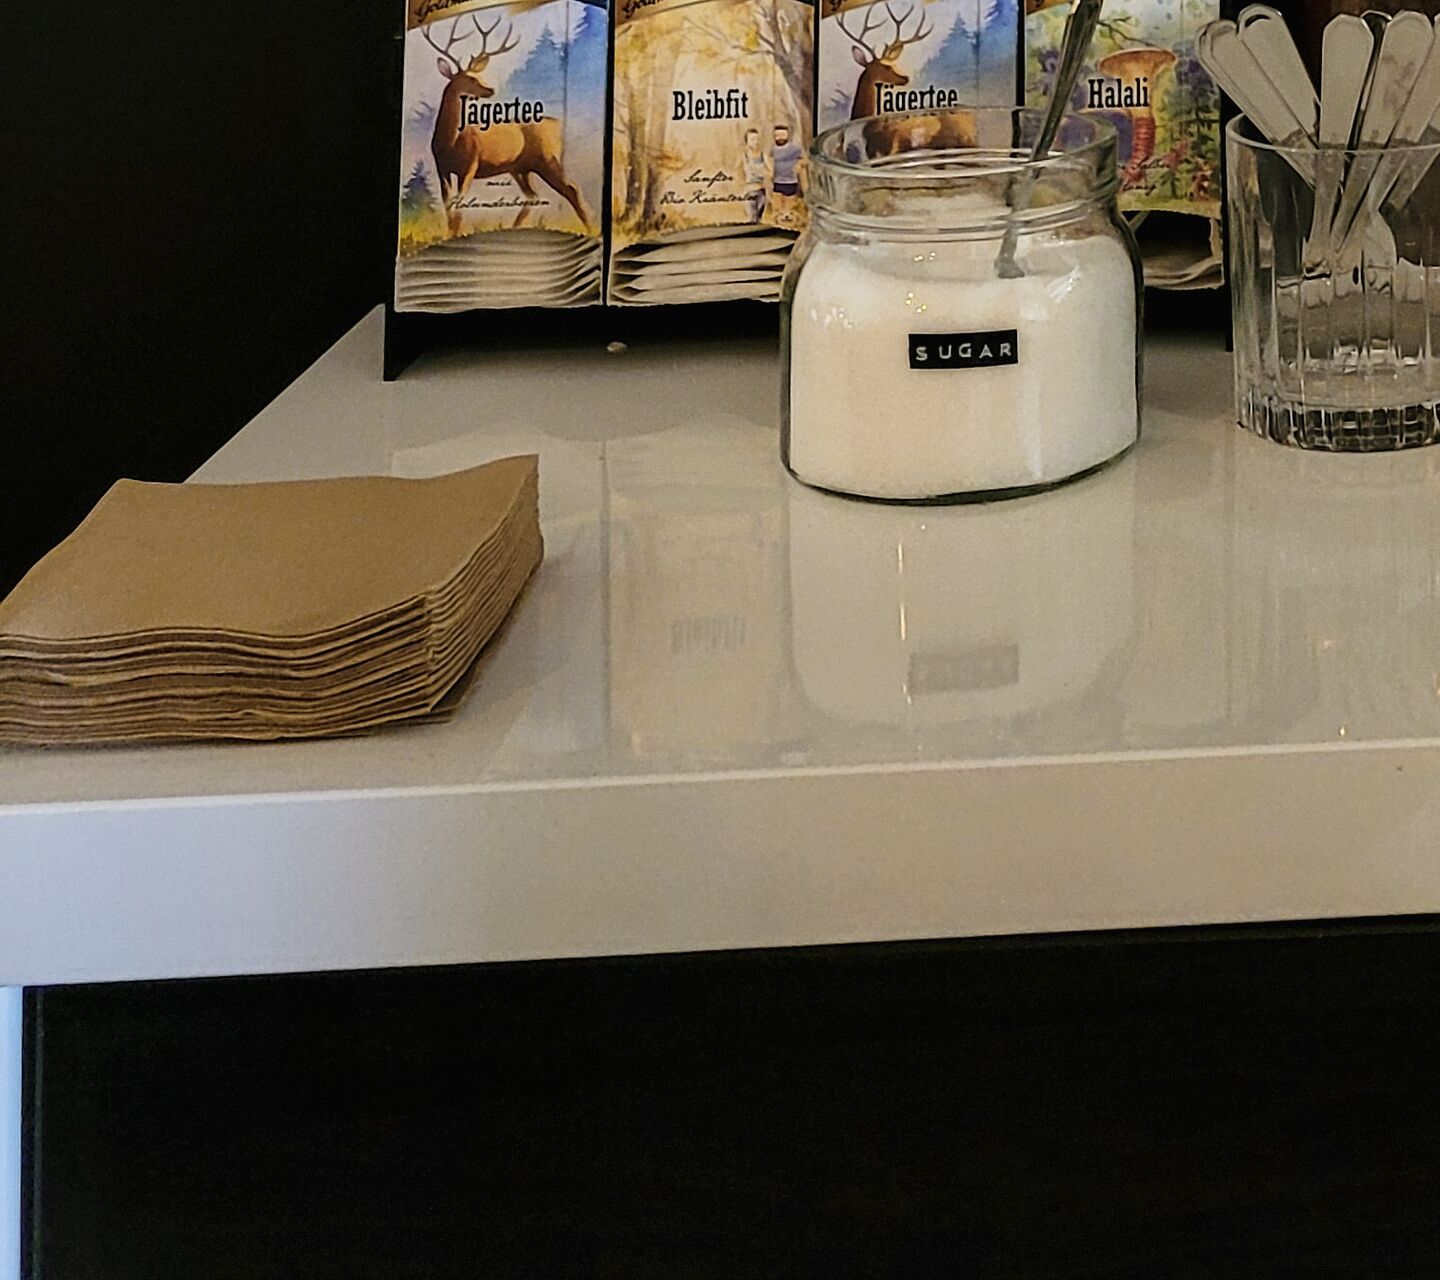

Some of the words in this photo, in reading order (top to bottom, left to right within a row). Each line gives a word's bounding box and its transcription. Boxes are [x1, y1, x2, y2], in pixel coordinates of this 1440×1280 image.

[672, 88, 749, 121] Bleibfit
[1087, 77, 1150, 108] Halali
[458, 95, 544, 131] Jägertee
[915, 342, 1012, 361] SUGAR
